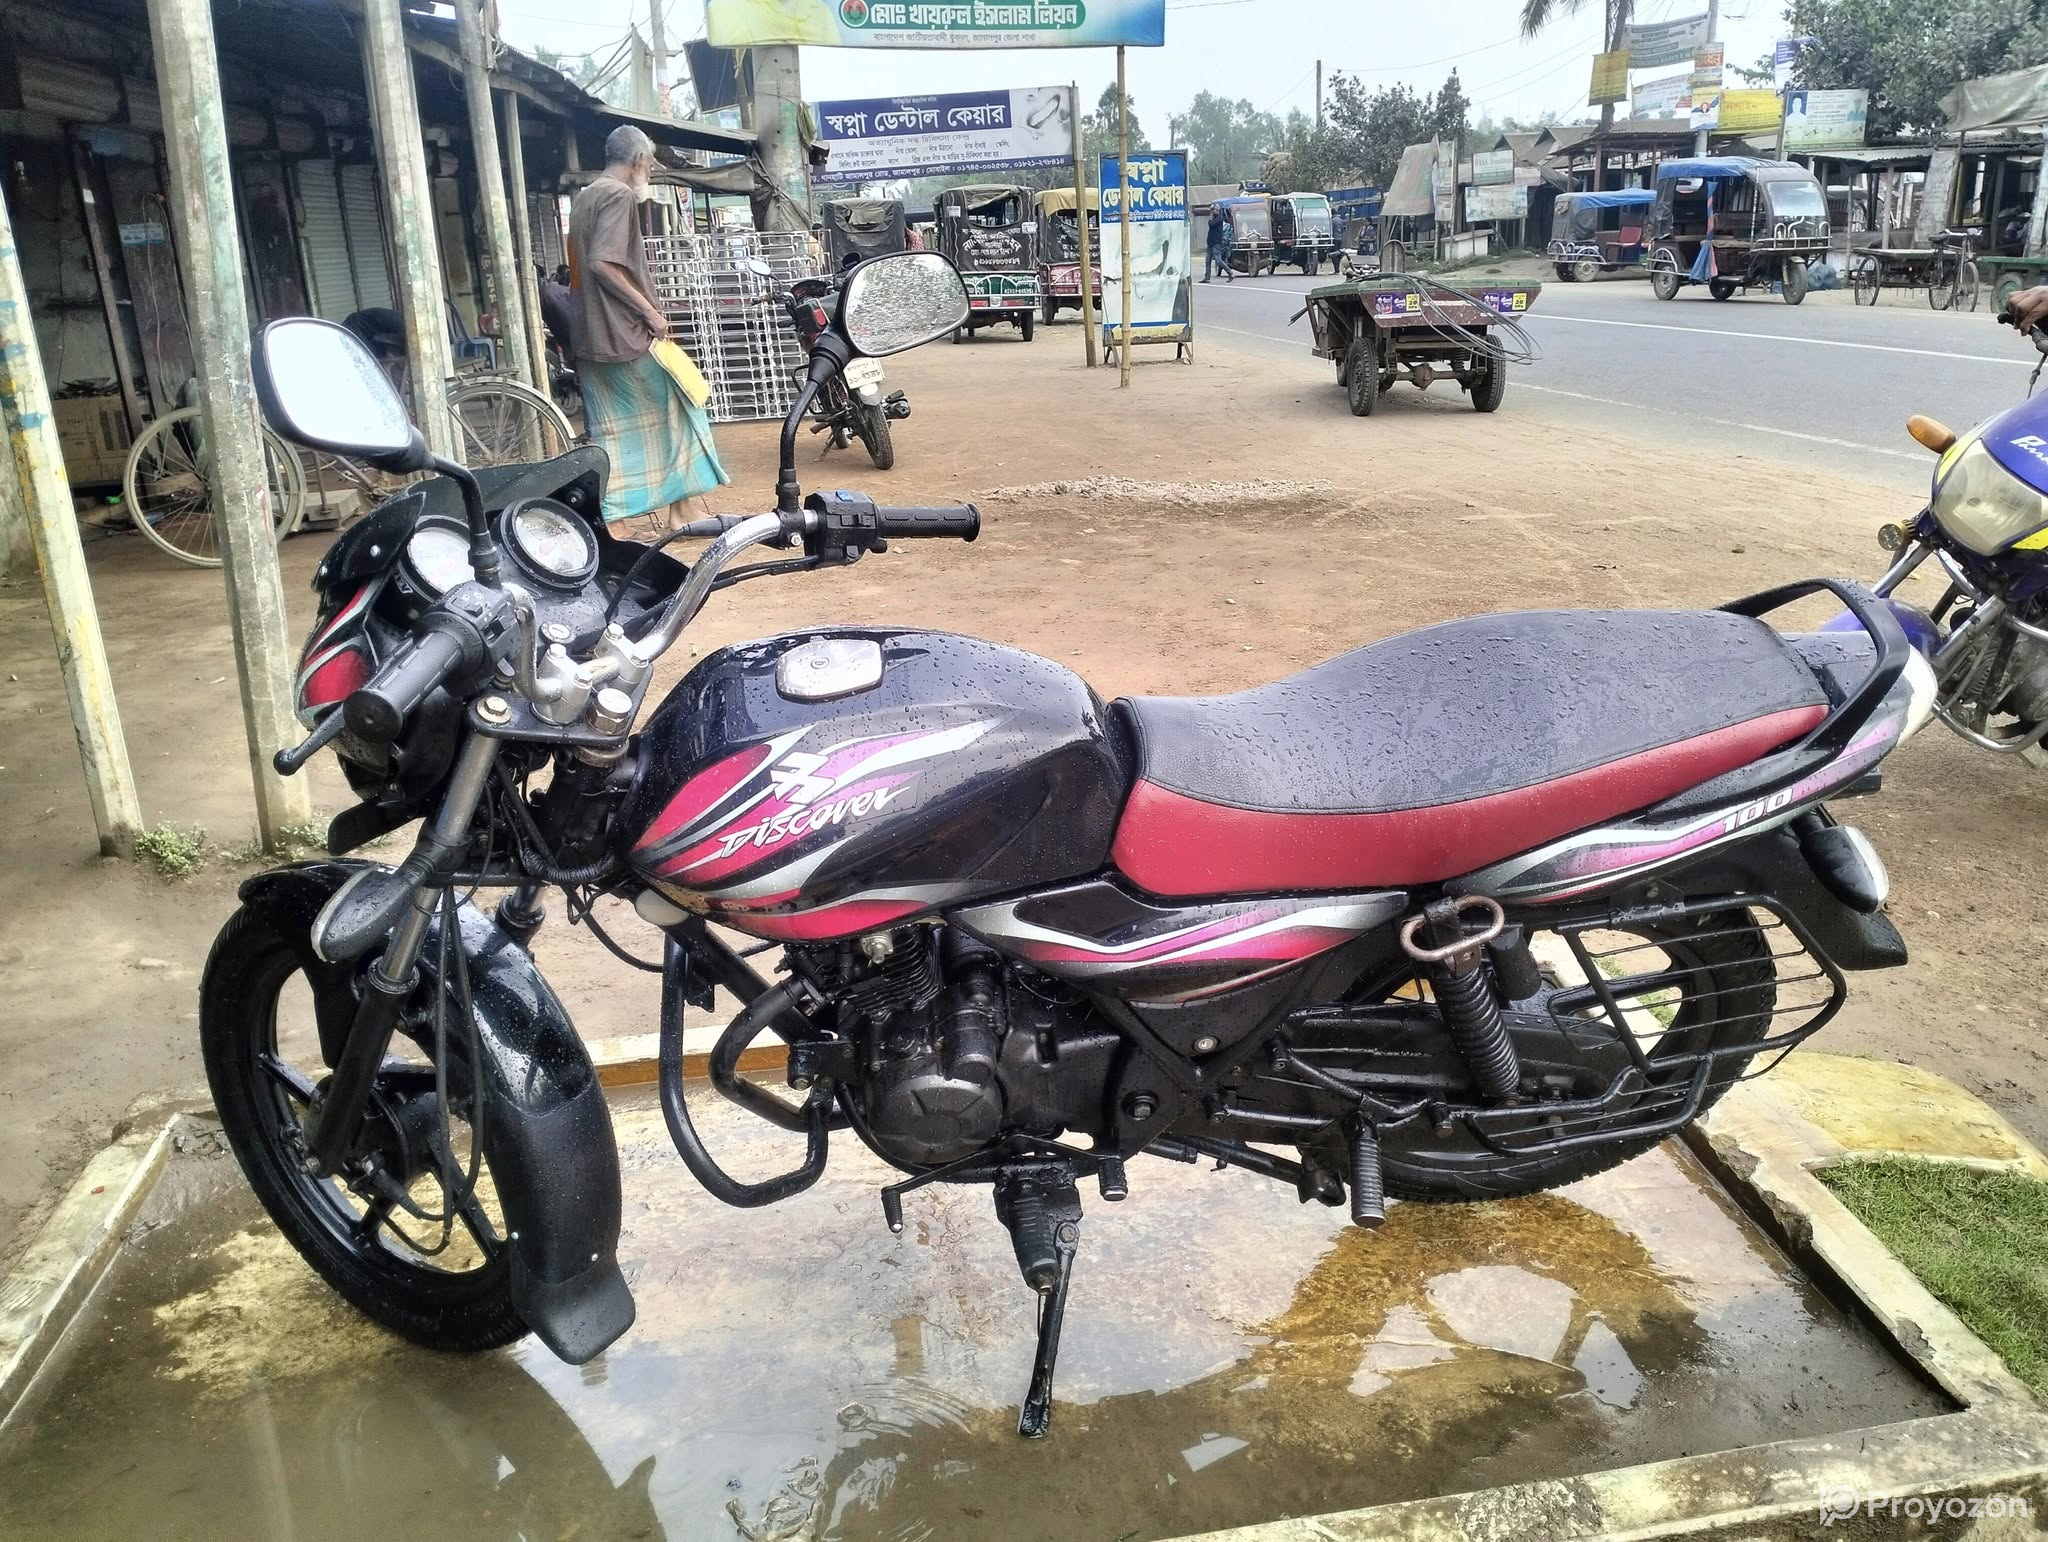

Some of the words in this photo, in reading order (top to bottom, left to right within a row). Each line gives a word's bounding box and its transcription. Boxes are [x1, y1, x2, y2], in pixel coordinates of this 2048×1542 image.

[871, 4, 906, 25] মোঃ
[908, 4, 971, 29] খায়রুল
[974, 1, 1031, 26] ইসলাম
[825, 112, 867, 138] স্বপ্না
[874, 105, 940, 132] ডেন্টাল
[947, 103, 1006, 128] কেয়ার
[718, 786, 912, 859] Discover
[1722, 788, 1794, 834] 100
